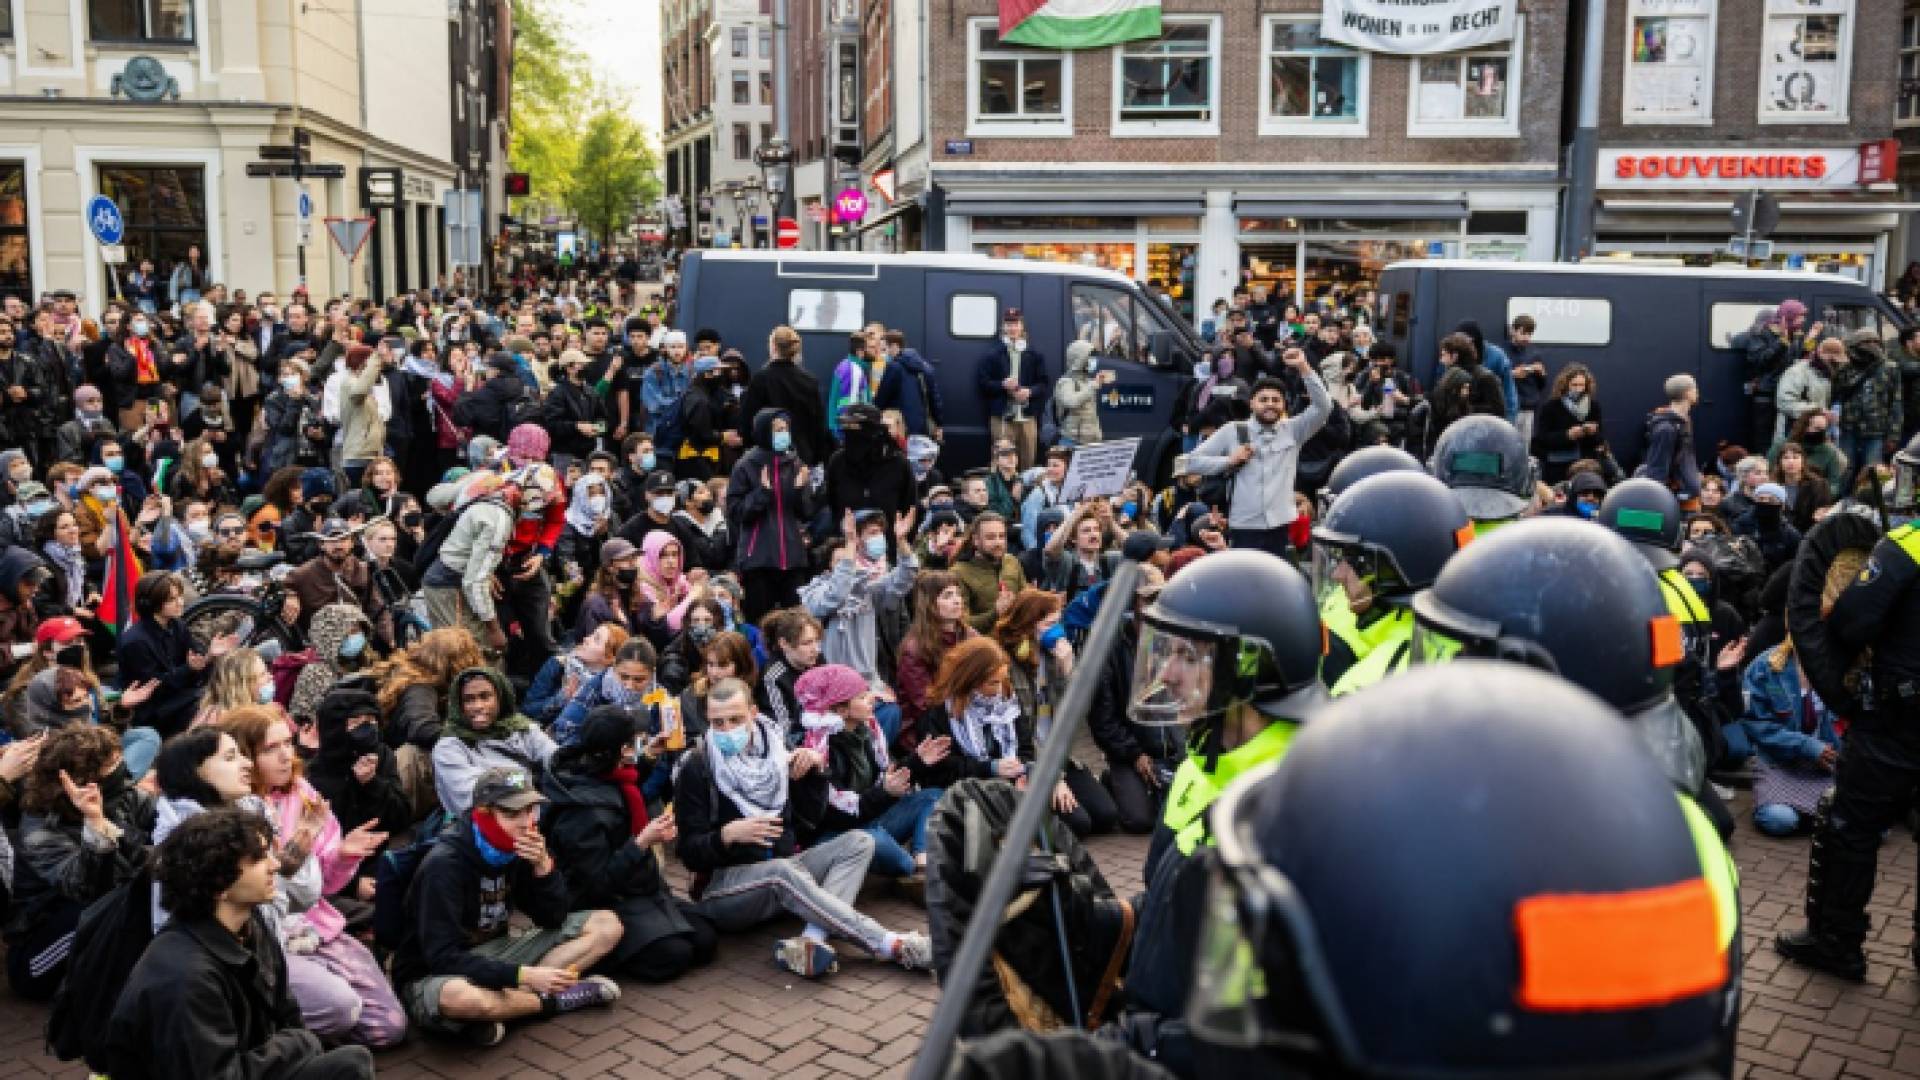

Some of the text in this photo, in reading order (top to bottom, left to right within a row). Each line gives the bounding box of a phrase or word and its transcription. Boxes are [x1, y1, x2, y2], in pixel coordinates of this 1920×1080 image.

[1342, 11, 1402, 36] WONEN
[1451, 6, 1501, 32] RECHT
[1615, 155, 1827, 179] SOUVENIRS
[1101, 393, 1153, 407] PLITIE
